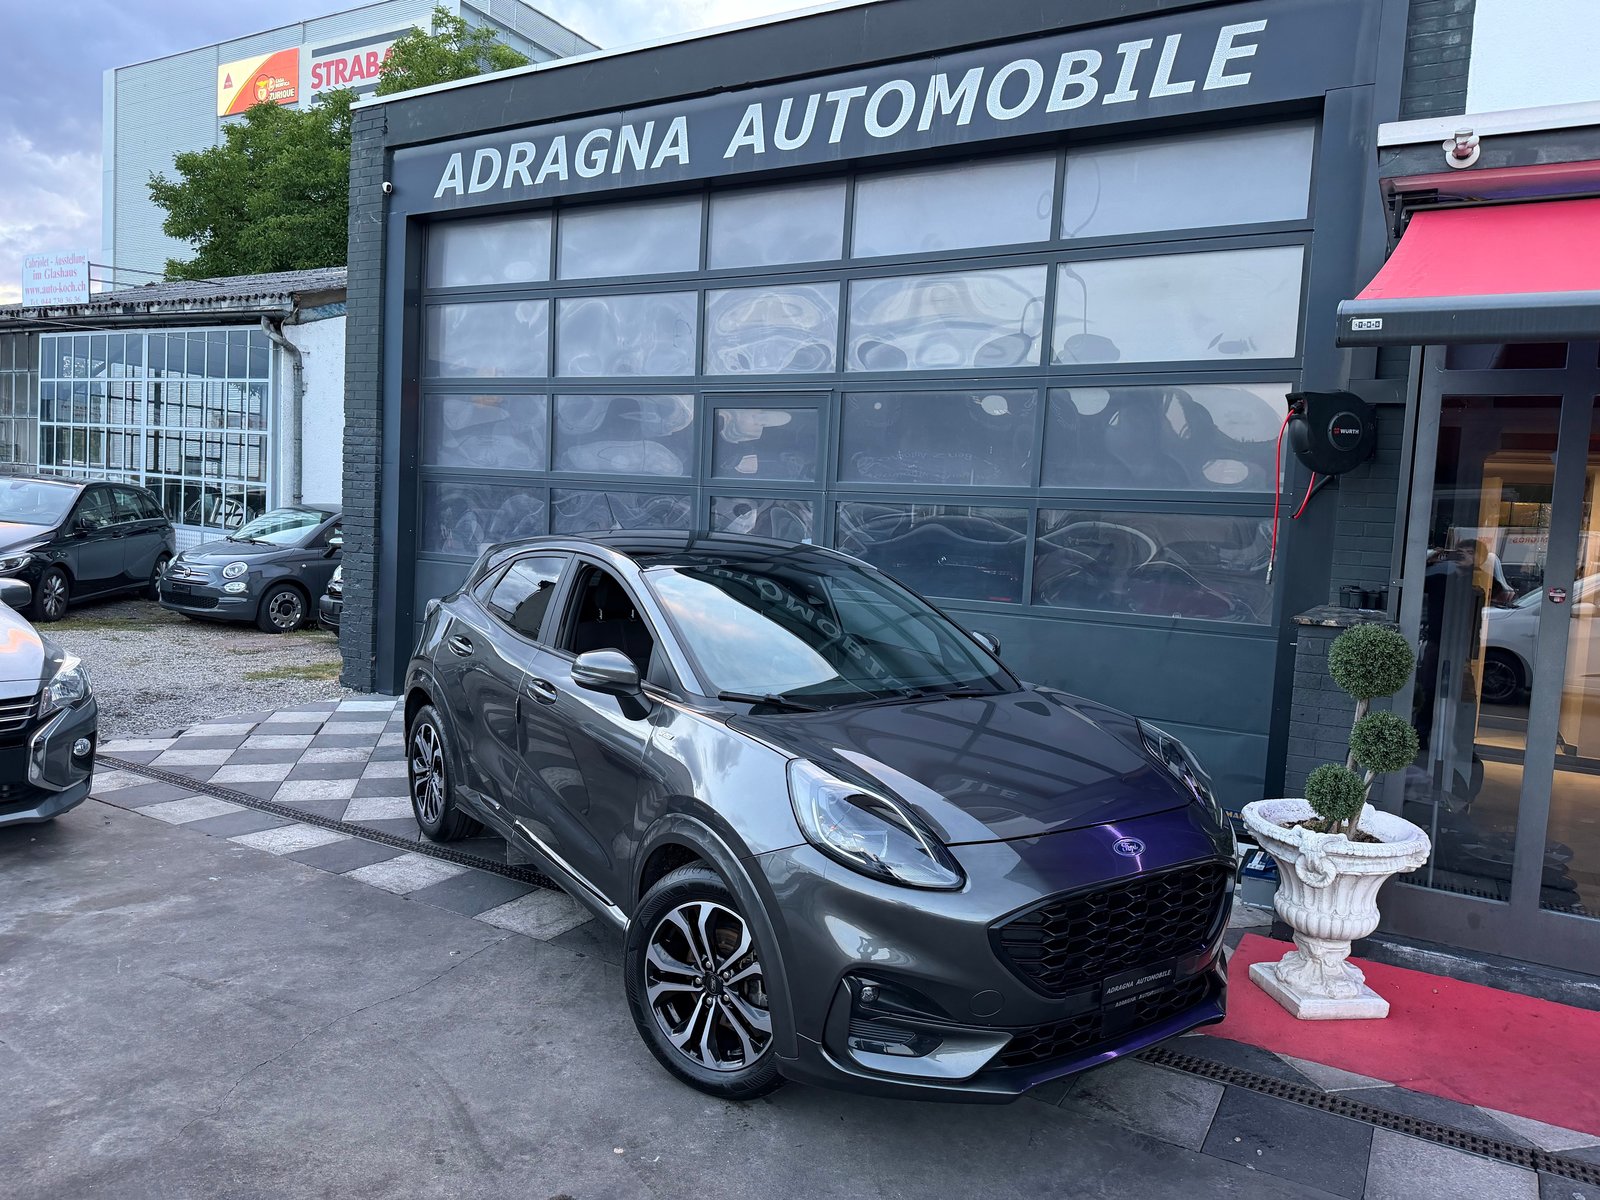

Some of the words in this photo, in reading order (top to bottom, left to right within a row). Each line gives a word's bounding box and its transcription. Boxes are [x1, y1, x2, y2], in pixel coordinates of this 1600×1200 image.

[269, 88, 295, 100] ZURIQUE
[433, 116, 690, 199] ADRAGNA
[723, 19, 1268, 159] AUTOMOBILE
[55, 253, 85, 264] Ausstellung
[33, 270, 42, 280] im
[44, 267, 77, 279] Glashaus
[25, 281, 86, 295] www.auto-koch.ch
[1106, 981, 1134, 994] ADRAGNA
[1136, 969, 1172, 985] AUTOMOBILE
